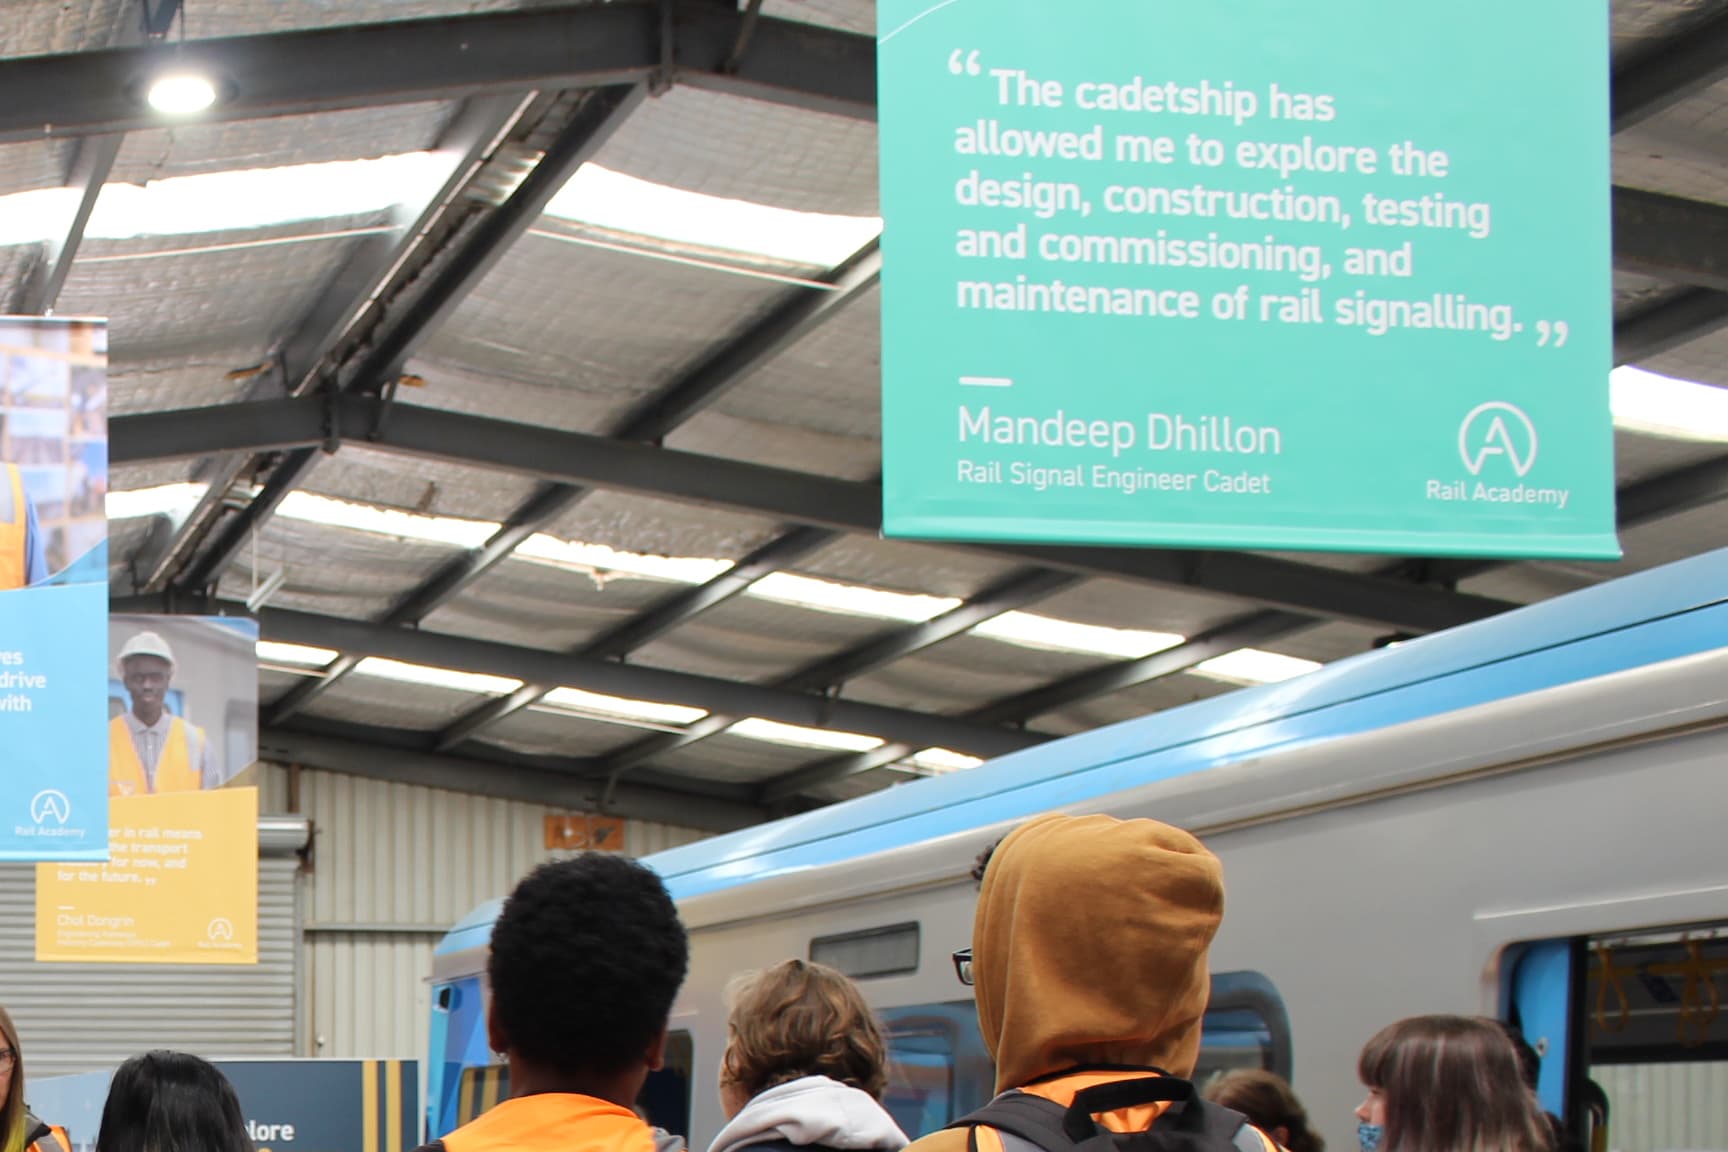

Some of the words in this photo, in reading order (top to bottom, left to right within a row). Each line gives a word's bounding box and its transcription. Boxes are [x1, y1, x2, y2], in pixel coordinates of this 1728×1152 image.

[1075, 76, 1257, 125] cadetship
[1270, 84, 1335, 123] has
[954, 120, 1103, 162] allowed
[1116, 133, 1175, 165] me
[1187, 135, 1224, 167] to
[1236, 138, 1377, 179] explore
[1389, 140, 1449, 177] the
[955, 172, 1092, 218] design,
[1103, 181, 1351, 229] construction,
[1363, 194, 1490, 238] testing
[955, 224, 1026, 260] and
[1038, 228, 1331, 281] commissioning,
[1344, 241, 1412, 277] and
[957, 276, 1199, 320] maintenance
[1212, 284, 1248, 321] of
[1260, 288, 1323, 324] rail
[958, 405, 1135, 457] Mandeep
[1148, 413, 1281, 454] Dhillon
[957, 461, 1002, 486] Rail
[1011, 462, 1084, 492] Signal
[1092, 465, 1196, 495] Engineer
[1203, 467, 1271, 494] Cadet
[1426, 480, 1465, 503] Rail
[1473, 481, 1569, 508] Academy
